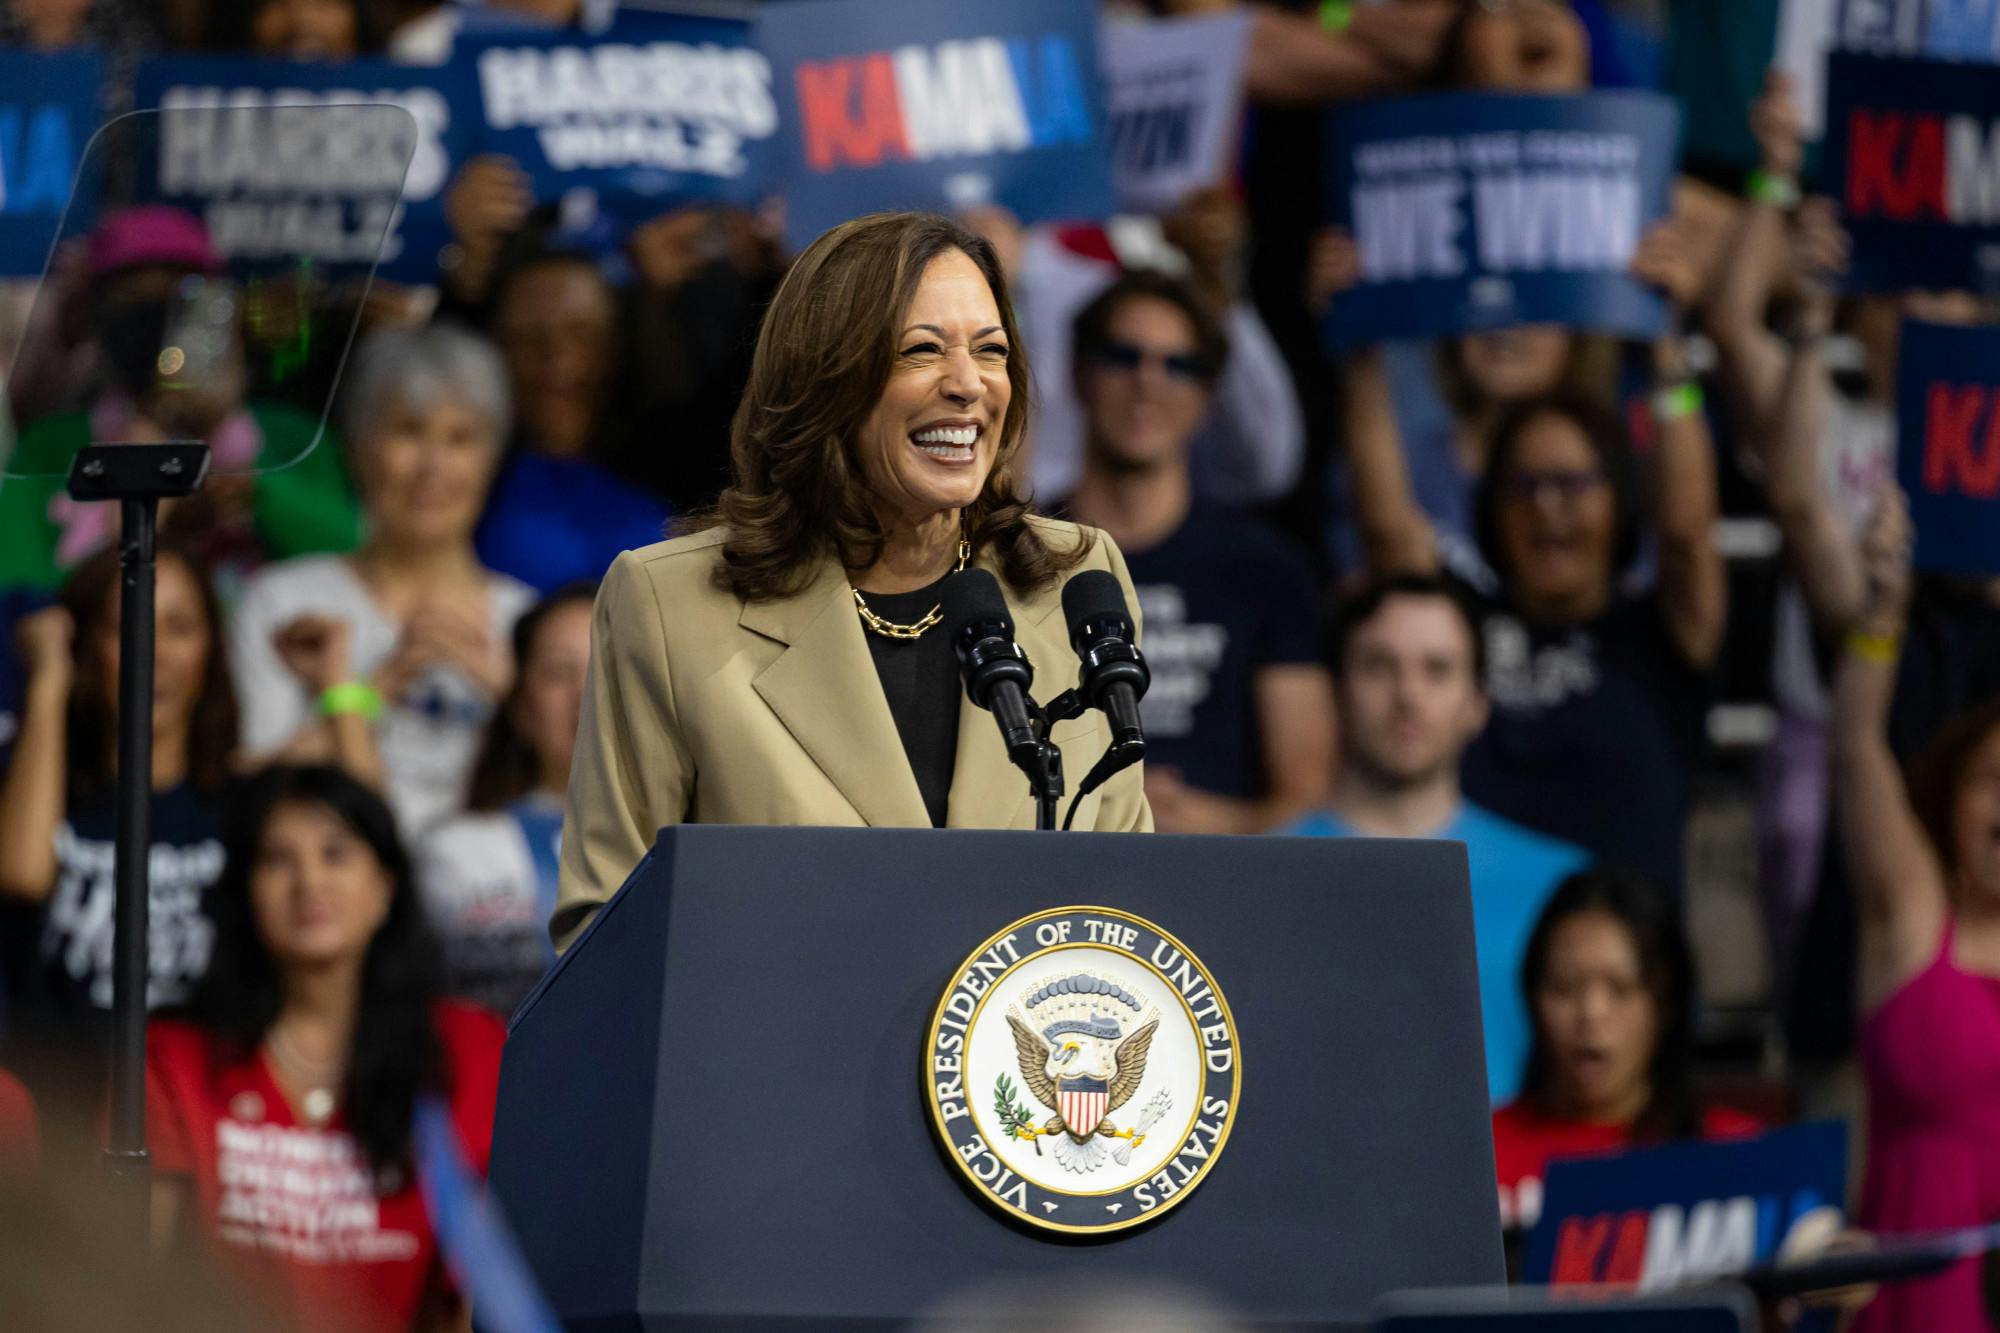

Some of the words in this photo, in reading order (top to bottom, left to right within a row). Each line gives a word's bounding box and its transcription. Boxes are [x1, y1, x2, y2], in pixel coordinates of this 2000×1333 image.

[158, 87, 449, 199] HARRIS
[479, 43, 777, 137] HARRIS
[797, 36, 1090, 171] KAMALA
[0, 102, 72, 212] LA
[538, 120, 746, 177] WALZ
[1353, 179, 1464, 284] WE
[1474, 172, 1638, 272] WIN
[1035, 920, 1071, 946] OF
[1084, 920, 1139, 951] THE
[935, 934, 1021, 1122] PRESIDENT
[1151, 940, 1233, 1074] UNITED
[958, 1134, 1027, 1212] VICE
[1133, 1095, 1229, 1212] STATES
